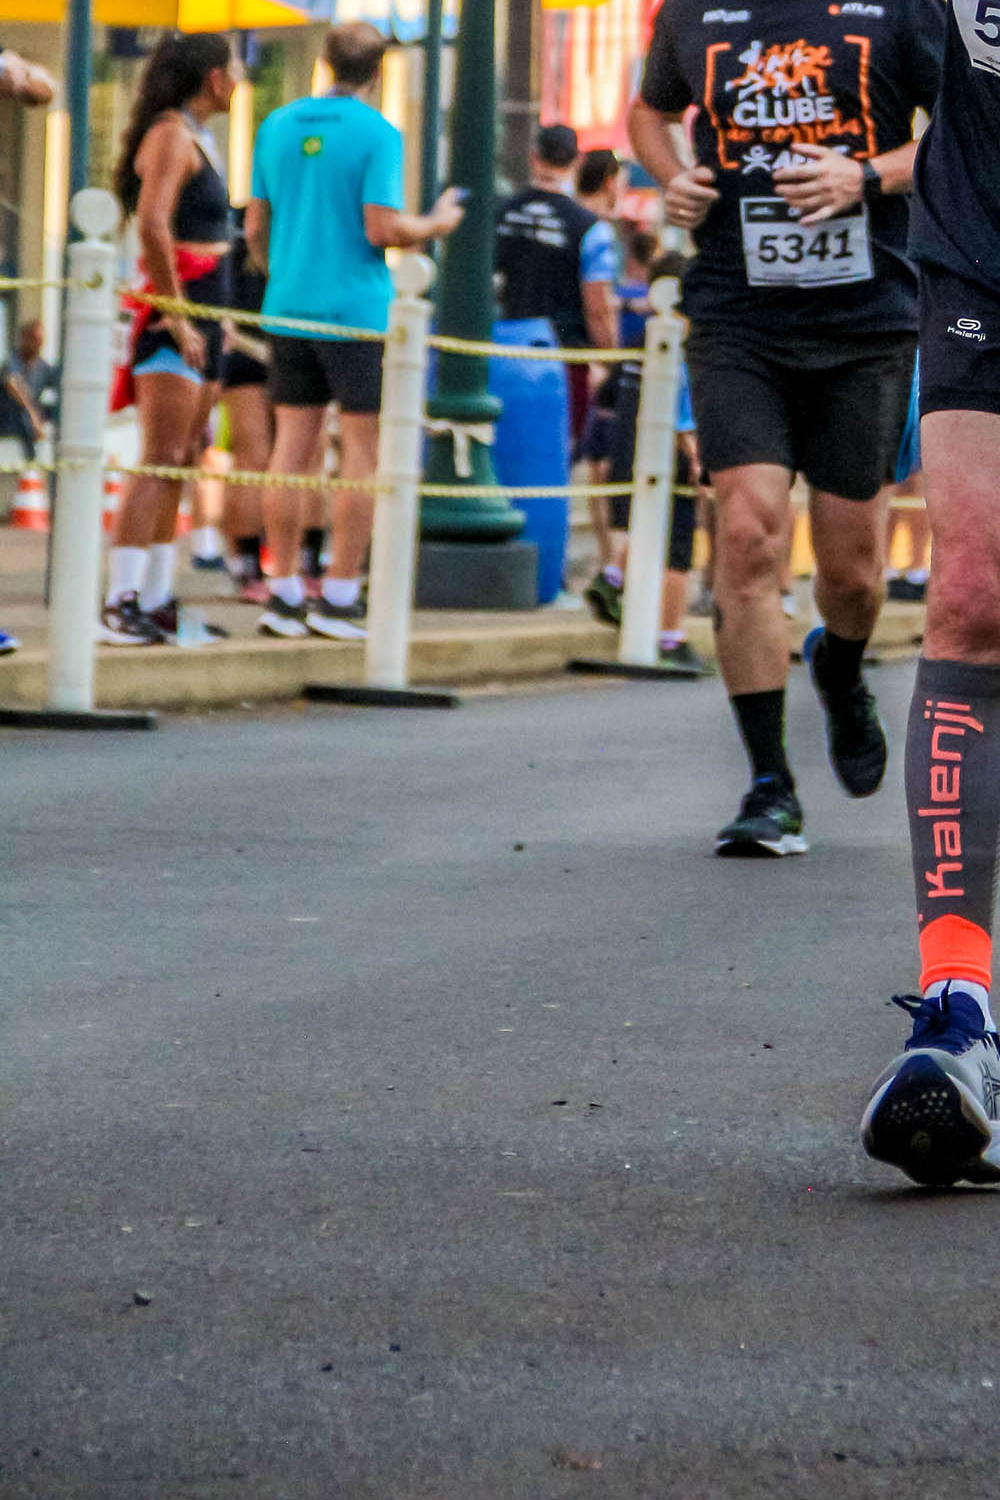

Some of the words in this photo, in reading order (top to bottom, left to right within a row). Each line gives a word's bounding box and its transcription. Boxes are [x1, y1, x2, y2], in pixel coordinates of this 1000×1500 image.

[733, 94, 835, 127] CLUBE
[758, 228, 853, 264] 5341
[946, 326, 987, 342] kalenji
[917, 699, 984, 899] kalenji
